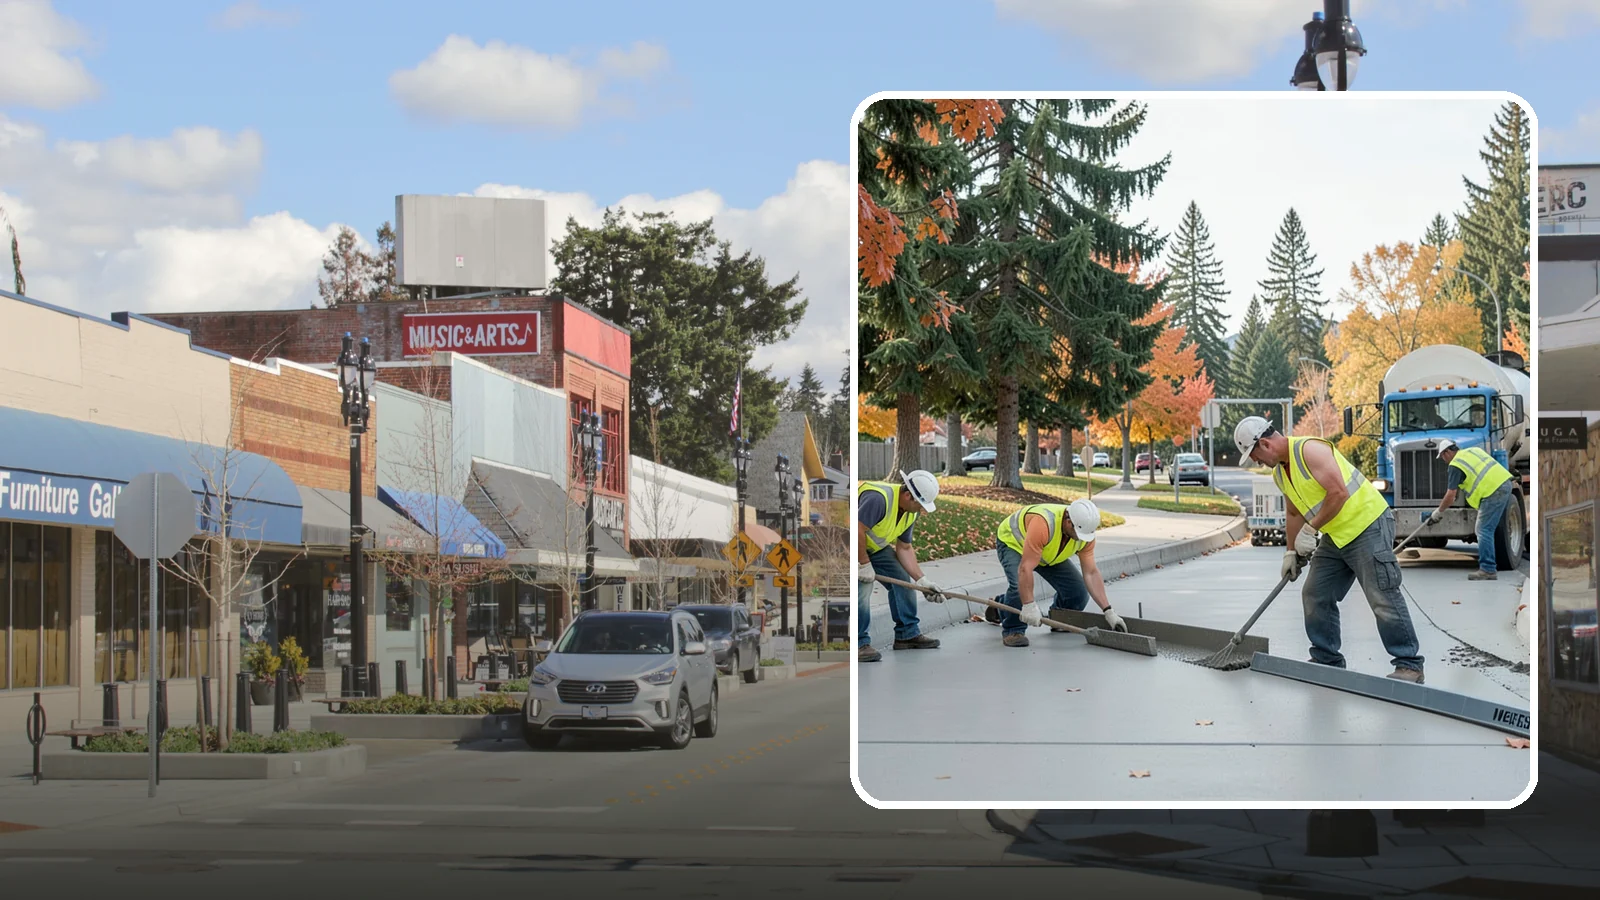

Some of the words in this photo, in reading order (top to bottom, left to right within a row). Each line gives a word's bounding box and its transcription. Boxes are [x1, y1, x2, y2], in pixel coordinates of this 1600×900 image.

[409, 322, 520, 349] MUSIC&ARTS
[0, 471, 79, 515] Furniture
[89, 482, 121, 519] Gal
[453, 563, 480, 574] SUSHI
